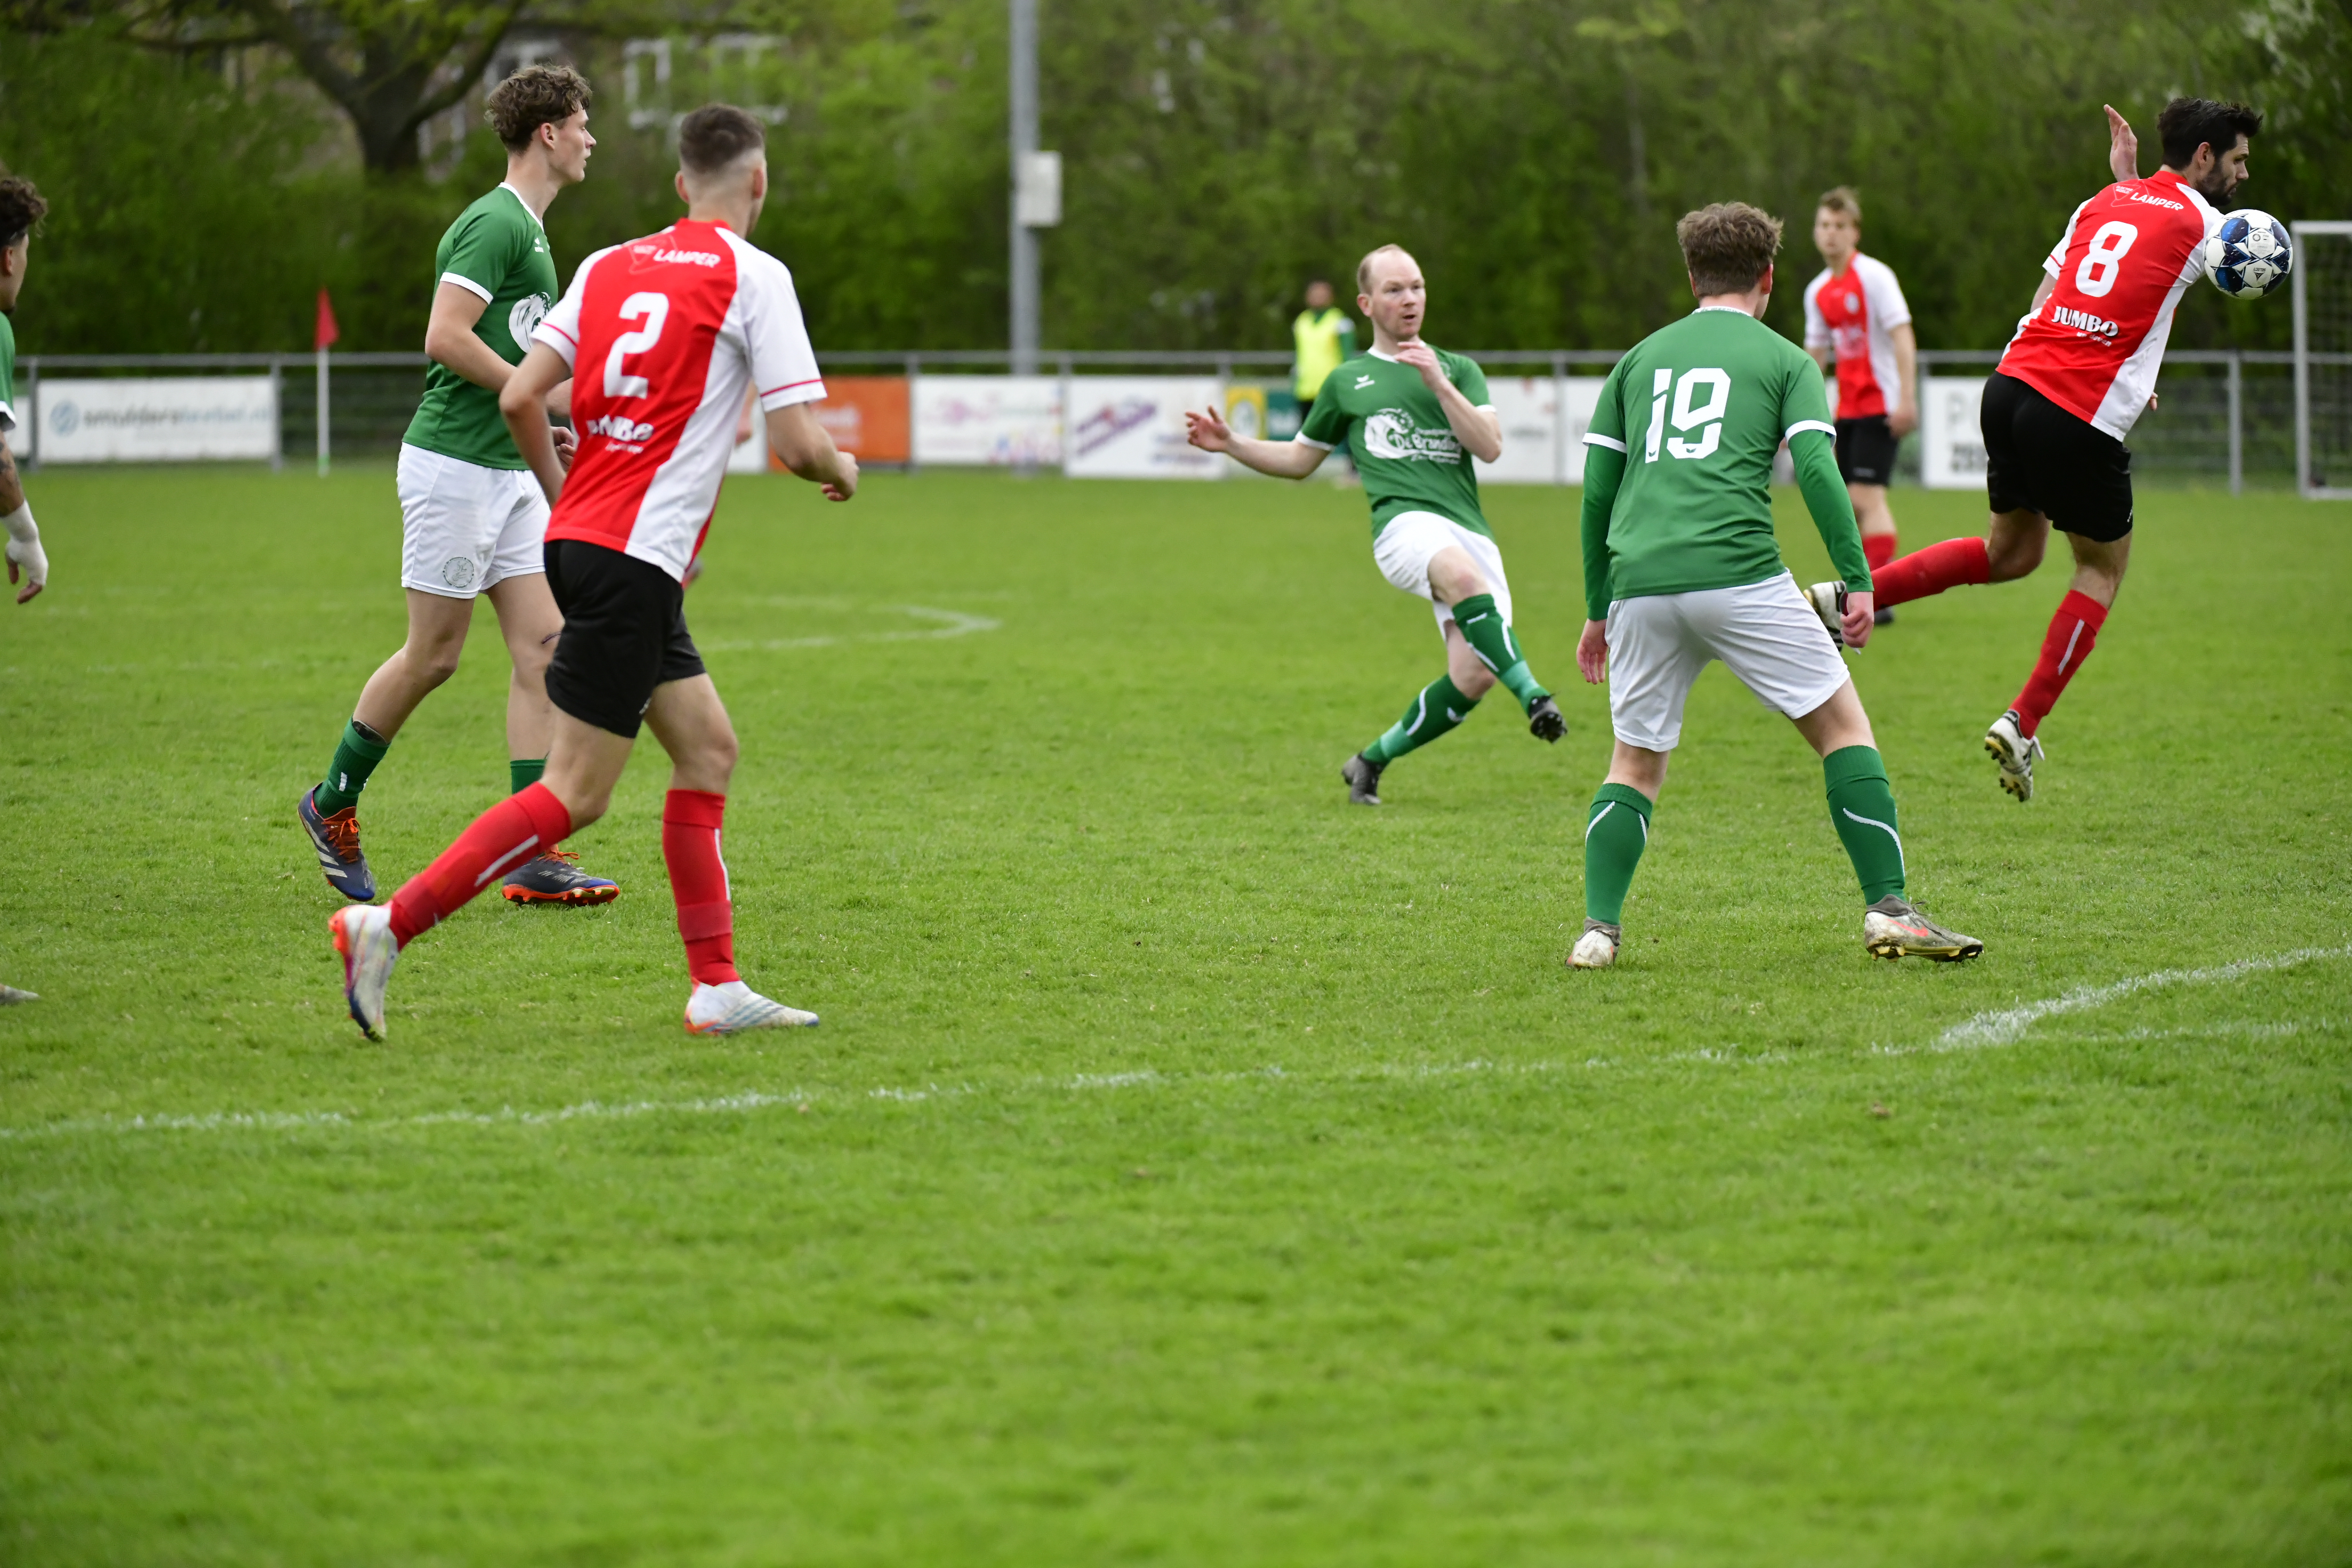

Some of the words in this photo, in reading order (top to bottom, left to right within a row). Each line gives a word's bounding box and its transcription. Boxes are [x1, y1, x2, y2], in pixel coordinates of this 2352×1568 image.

[2130, 192, 2184, 211] LAMPER
[653, 248, 721, 268] LAMPER
[2076, 221, 2138, 297] 8
[603, 291, 669, 399] 2
[2051, 306, 2118, 337] JUMBO
[1645, 368, 1731, 463] 19
